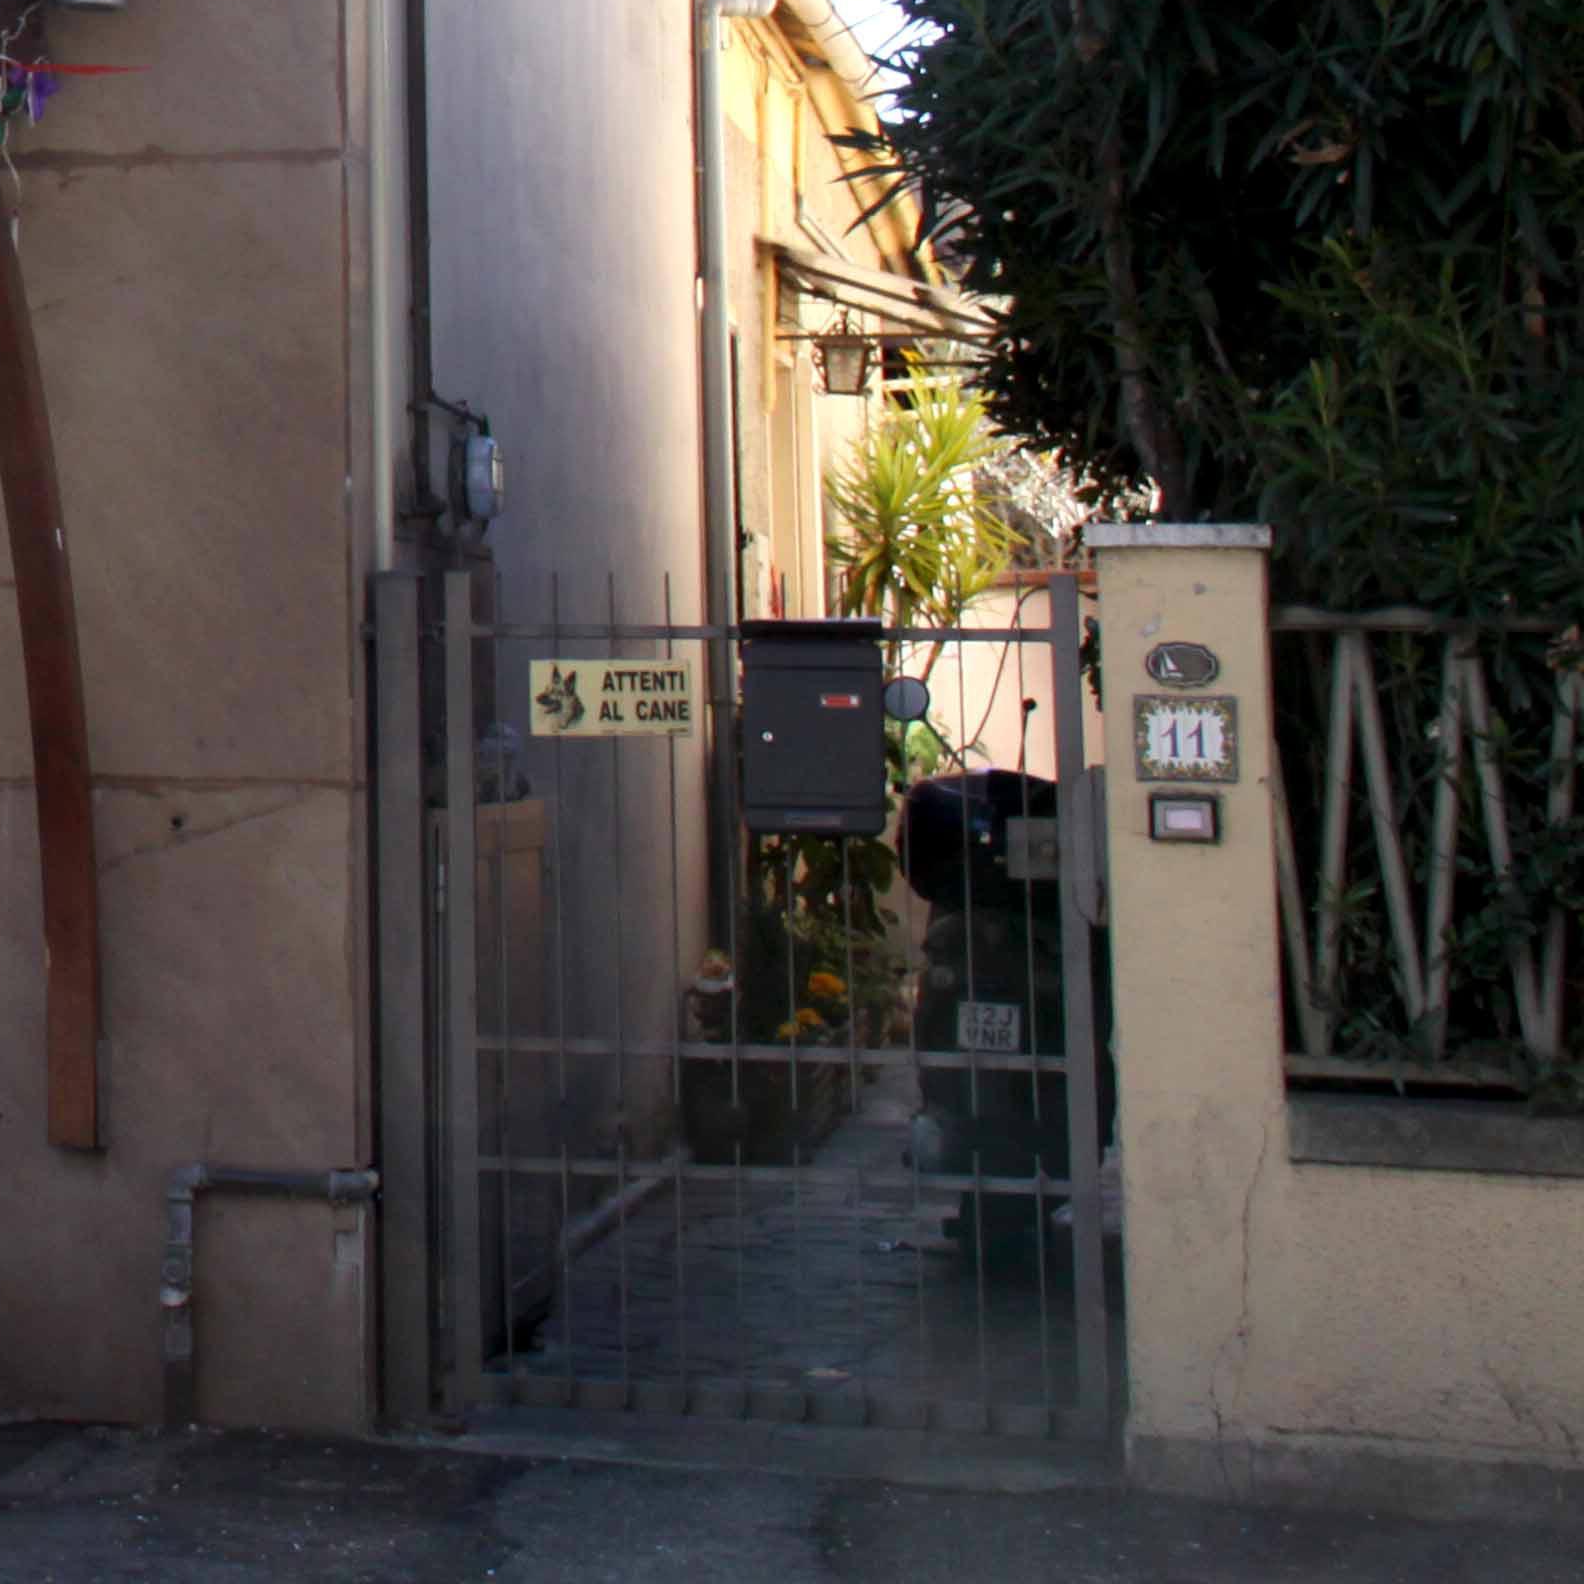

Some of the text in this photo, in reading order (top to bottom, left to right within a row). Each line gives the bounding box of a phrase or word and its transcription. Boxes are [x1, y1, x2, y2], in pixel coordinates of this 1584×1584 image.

[602, 670, 685, 692] ATTENTI
[599, 699, 690, 722] AL CANE
[1160, 719, 1206, 758] 11
